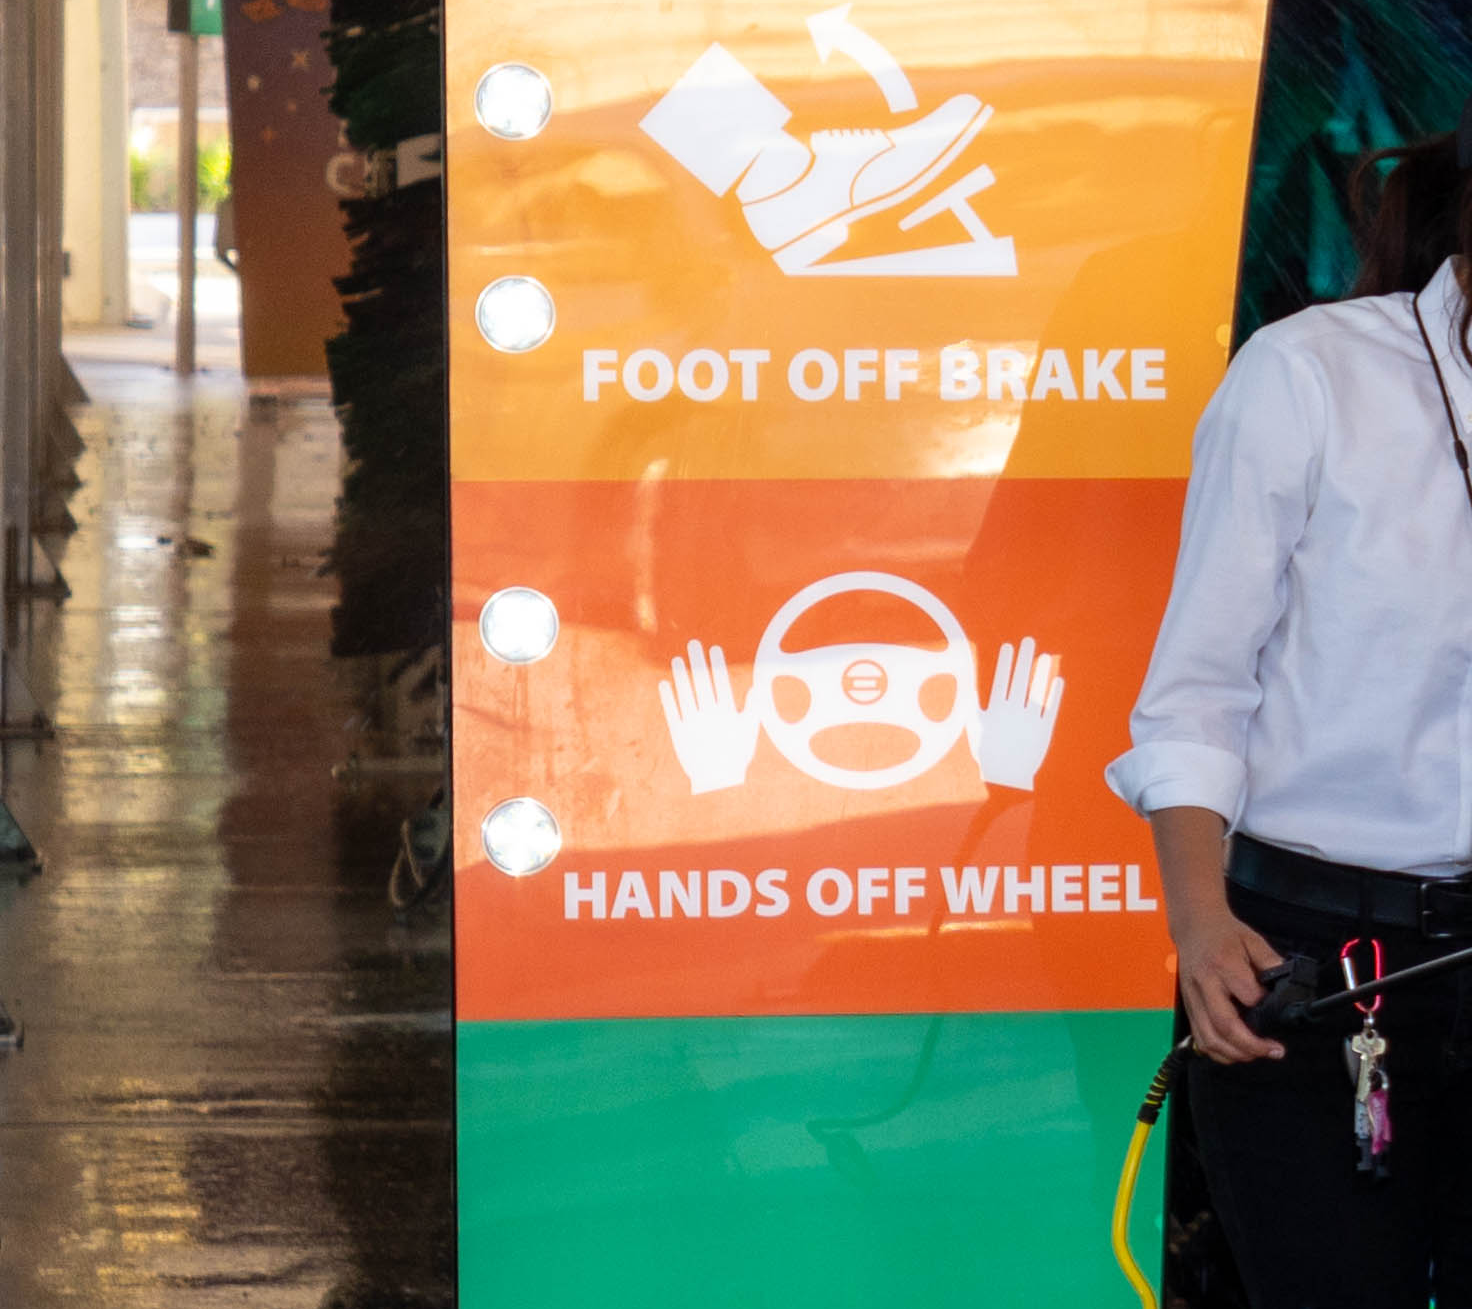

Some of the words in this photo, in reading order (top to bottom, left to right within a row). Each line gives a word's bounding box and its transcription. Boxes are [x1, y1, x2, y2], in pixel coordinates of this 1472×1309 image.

[581, 348, 770, 401] FOOT
[787, 348, 924, 401] OFF
[939, 348, 1167, 401] BRAKE
[563, 868, 790, 921] HANDS
[806, 866, 926, 917] OFF
[940, 864, 1157, 914] WHEEL
